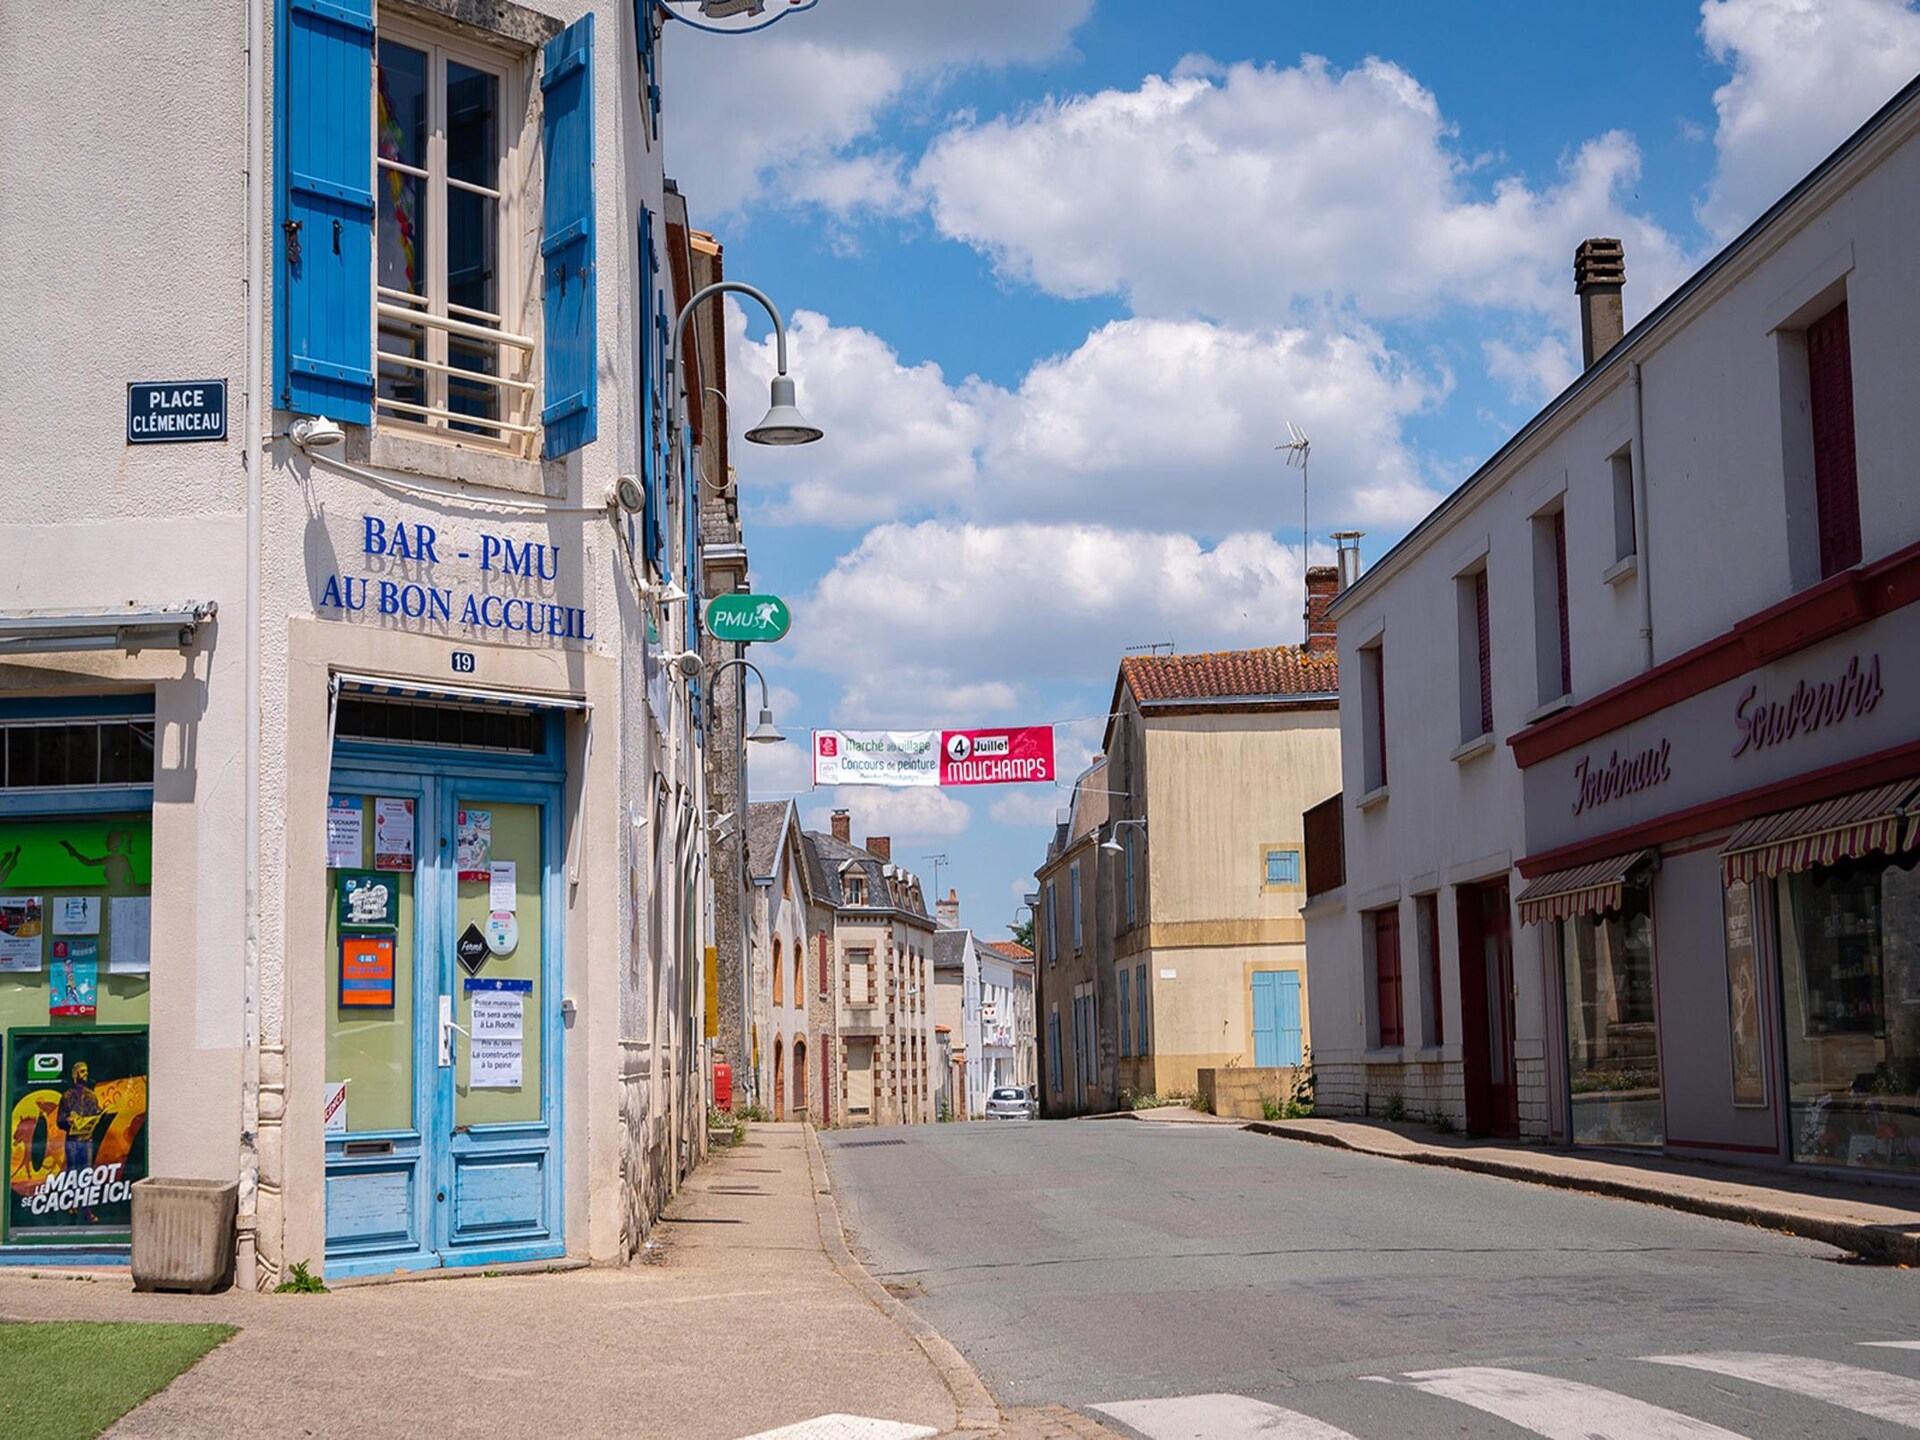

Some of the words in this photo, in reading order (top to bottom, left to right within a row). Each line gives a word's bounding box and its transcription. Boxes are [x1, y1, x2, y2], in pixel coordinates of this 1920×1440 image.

[149, 389, 204, 409] PLACE
[132, 412, 220, 433] CLÉMENCEAU
[362, 516, 440, 564] BAR
[480, 534, 560, 581] PMU
[319, 574, 369, 611] AU
[378, 580, 452, 622] BON
[460, 593, 595, 641] ACCUEIL
[714, 611, 754, 627] PMU
[454, 655, 472, 671] 19
[1731, 653, 1884, 758] Souvenirs
[845, 738, 884, 752] Marché
[898, 739, 931, 754] village
[954, 738, 966, 756] 4
[974, 739, 1008, 752] Juillet
[841, 757, 885, 771] Concours
[886, 761, 896, 770] de
[897, 758, 936, 773] peinture
[947, 757, 1046, 782] MOUCHAMPS
[1572, 737, 1671, 816] Journaux
[474, 1010, 485, 1018] Elle
[487, 1011, 501, 1019] sera
[486, 1020, 494, 1028] La
[495, 1020, 515, 1029] Roche
[472, 1051, 480, 1059] La
[481, 1051, 520, 1059] construction
[487, 1060, 493, 1068] la
[494, 1062, 512, 1070] peine
[35, 1184, 46, 1195] LE
[44, 1163, 122, 1194] MAGOT
[21, 1196, 33, 1208] SE
[31, 1185, 101, 1215] CACHE
